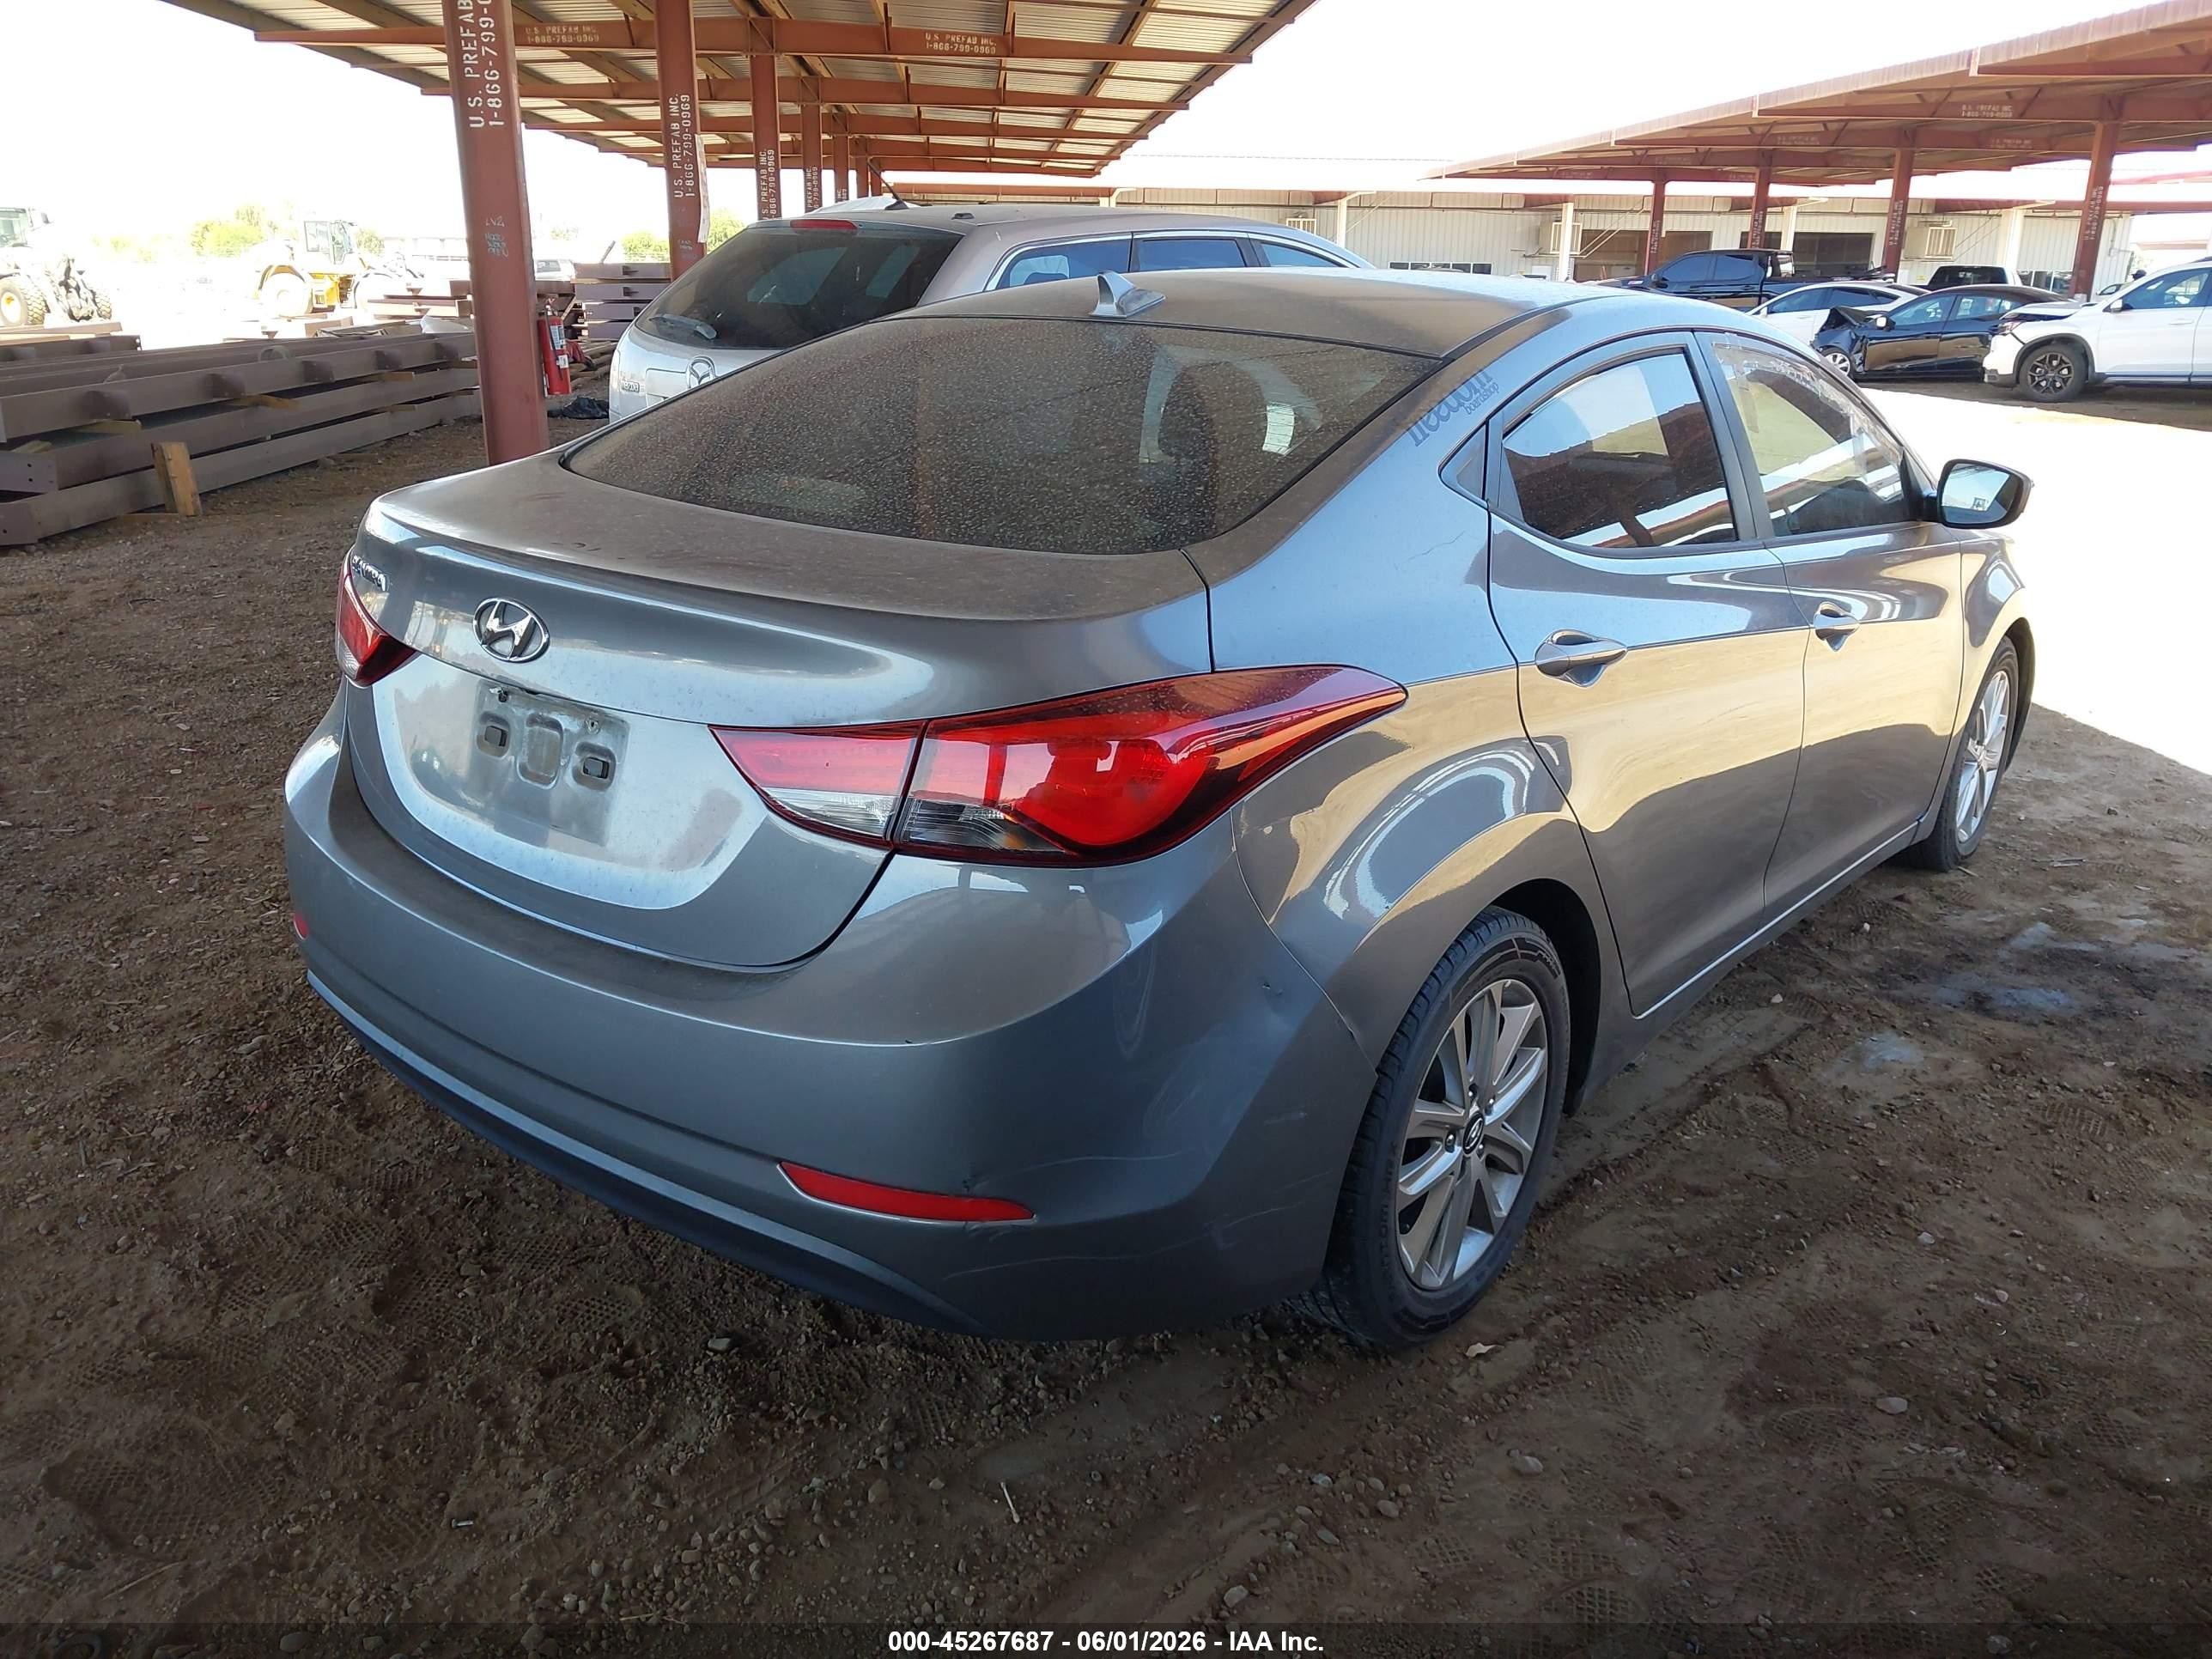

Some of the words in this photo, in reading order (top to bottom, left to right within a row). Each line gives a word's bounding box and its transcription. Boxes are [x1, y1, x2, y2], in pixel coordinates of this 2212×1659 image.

[458, 0, 480, 77] PREFAB
[945, 34, 977, 45] PREFAB
[467, 90, 485, 127] U.S.
[668, 93, 679, 116] INC.
[671, 123, 682, 168] PREFAB
[680, 94, 696, 197] 1-866-799-0969
[673, 175, 684, 198] U.S.
[760, 168, 769, 202] PREFAB
[1462, 382, 1499, 415] boardshop
